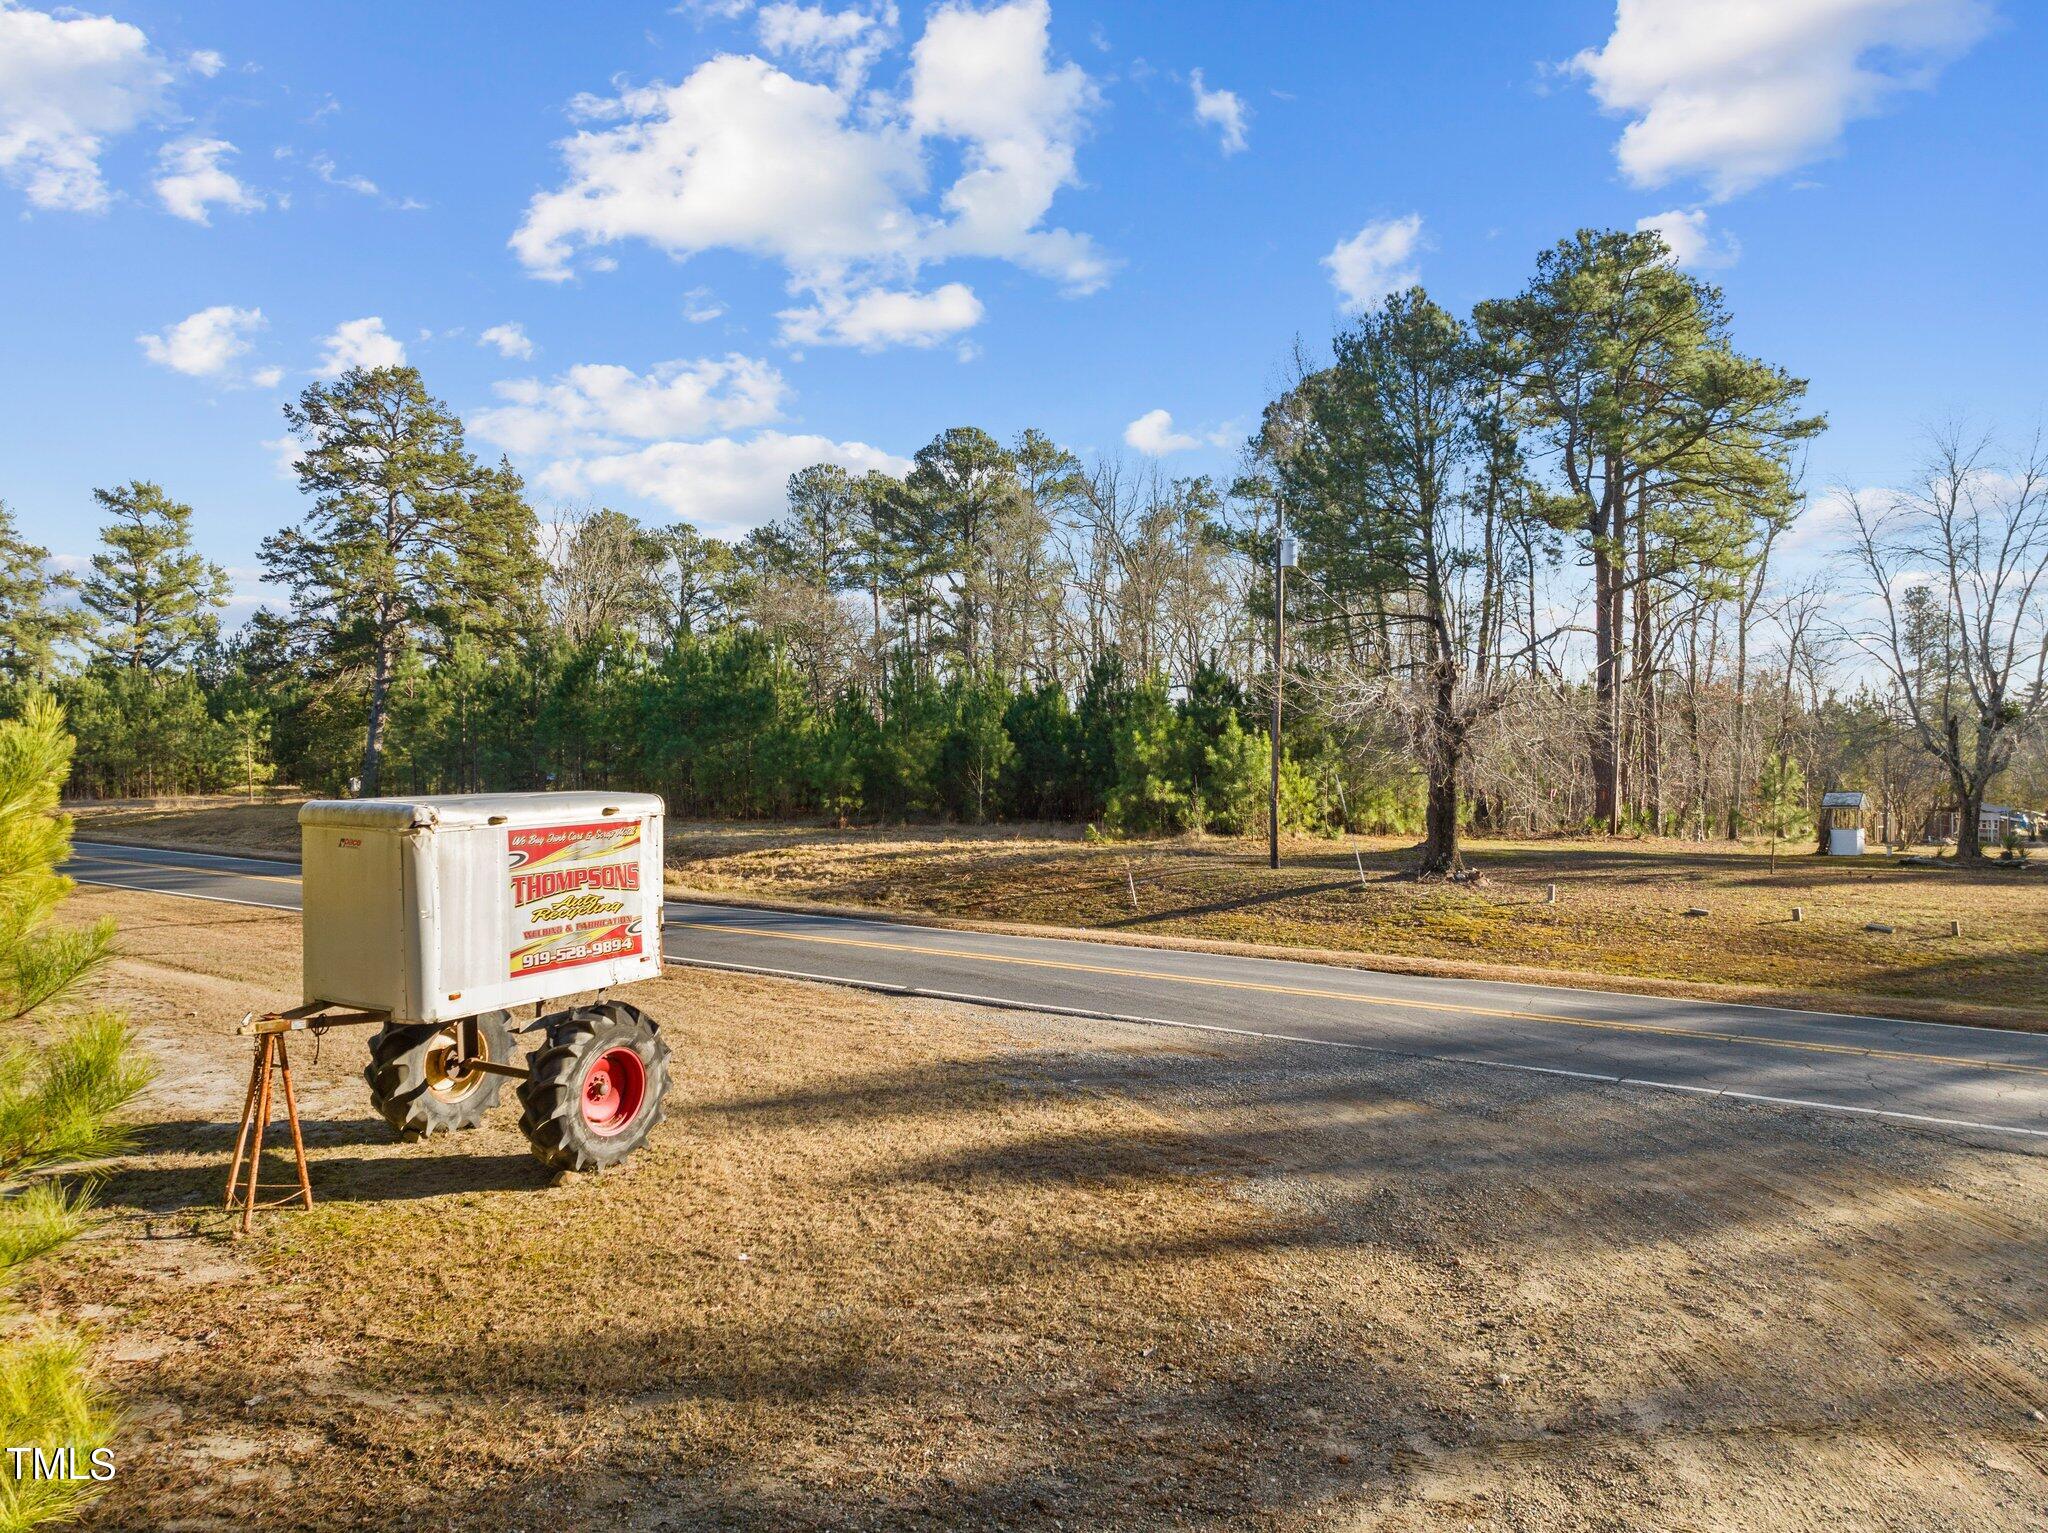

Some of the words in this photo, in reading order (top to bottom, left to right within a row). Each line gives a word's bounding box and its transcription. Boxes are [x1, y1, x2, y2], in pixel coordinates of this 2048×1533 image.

[512, 836, 526, 846] We
[528, 834, 545, 845] Buy
[511, 861, 640, 907] THOMPSONS
[551, 894, 604, 908] Auto
[531, 902, 624, 923] Recycling
[522, 926, 563, 939] WELDING
[565, 924, 574, 933] &
[576, 915, 633, 931] FABRICATION
[522, 936, 632, 968] 919-528-9894
